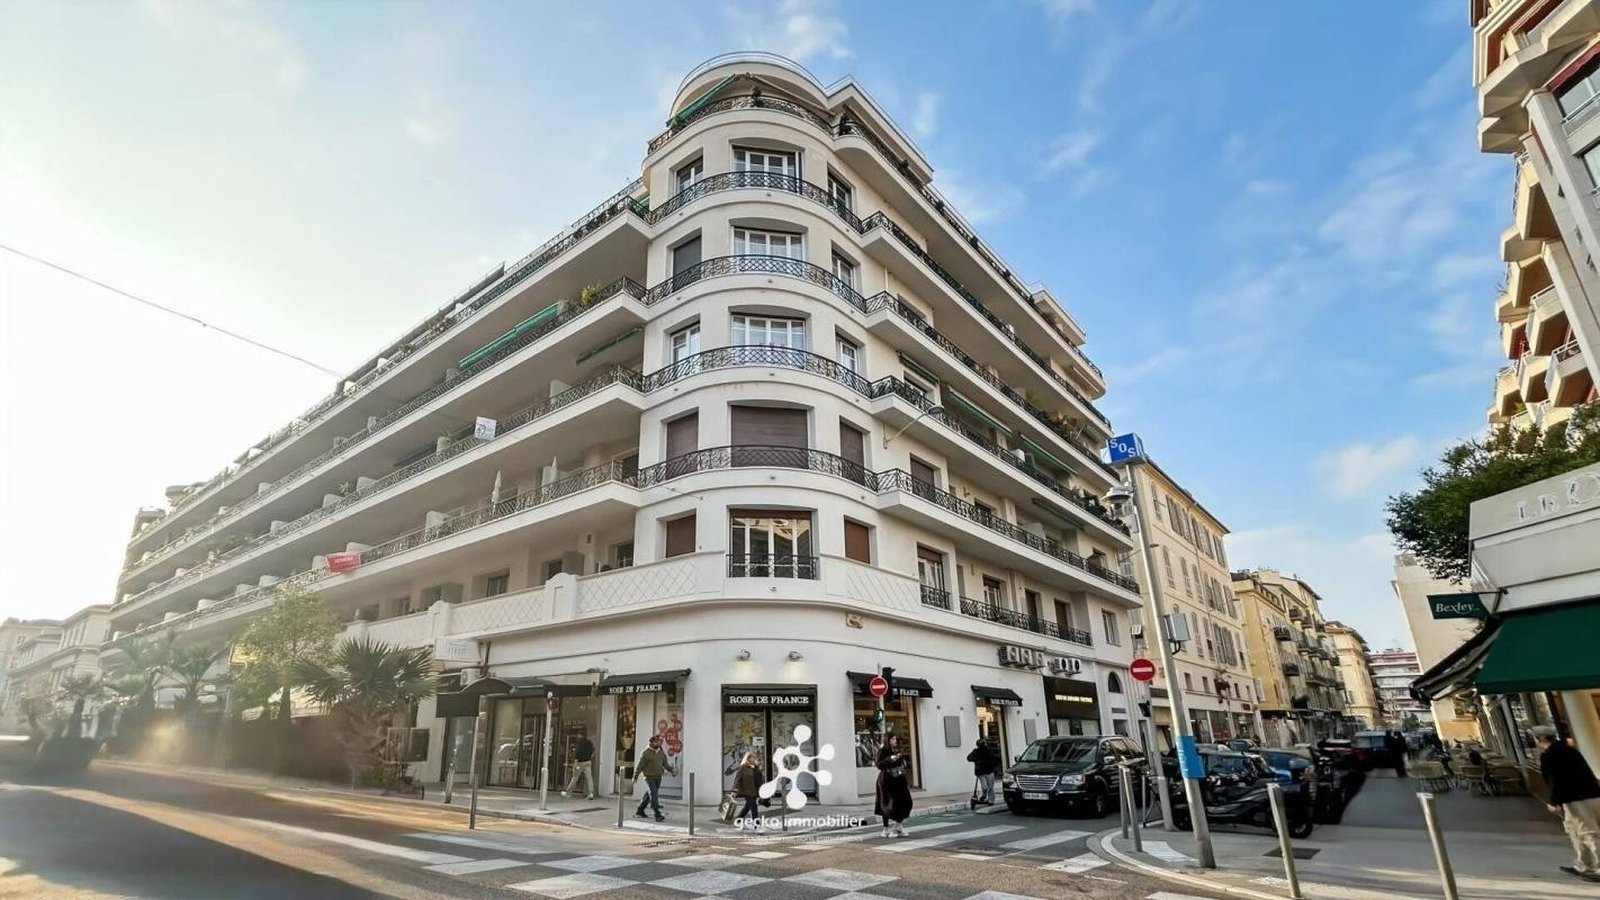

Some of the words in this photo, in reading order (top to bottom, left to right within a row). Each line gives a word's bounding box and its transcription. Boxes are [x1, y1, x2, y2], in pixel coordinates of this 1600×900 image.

[1110, 438, 1136, 457] SOS
[1435, 602, 1475, 614] Bexley
[729, 696, 754, 704] ROSE
[756, 696, 768, 704] DE
[771, 696, 809, 704] FRANCE
